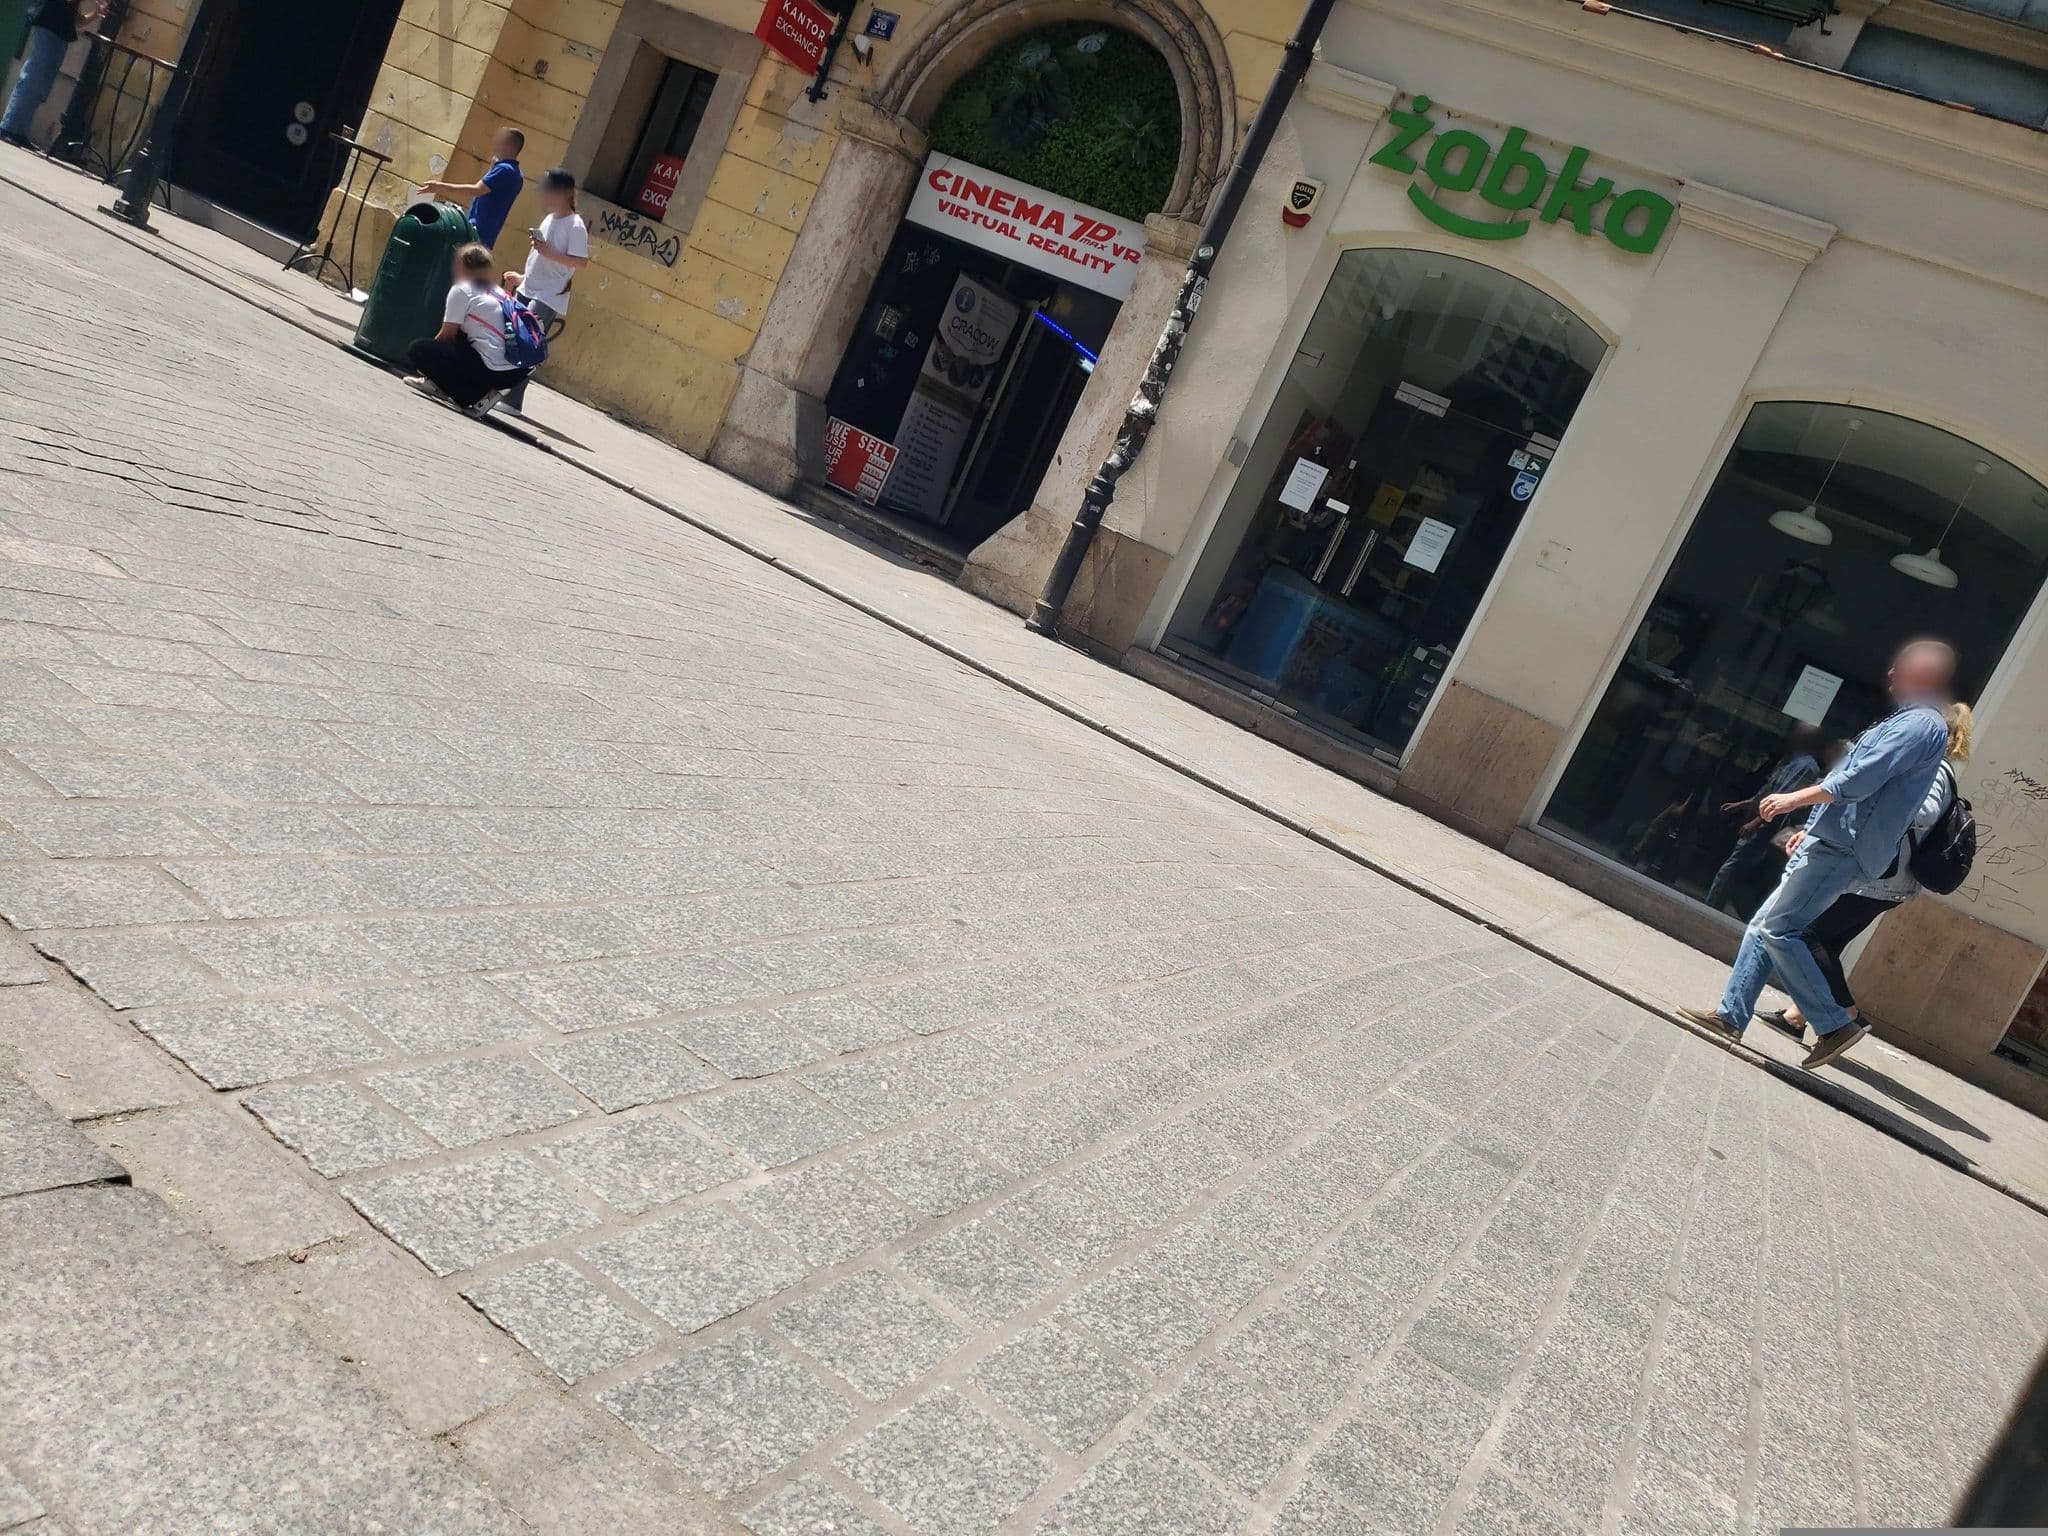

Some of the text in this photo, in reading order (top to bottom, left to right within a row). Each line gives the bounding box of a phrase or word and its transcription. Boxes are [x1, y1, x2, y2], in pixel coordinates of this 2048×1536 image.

[775, 16, 819, 57] EXCHANGE
[782, 0, 826, 41] KANTOR
[1369, 95, 1675, 254] żabka
[928, 169, 1065, 236] CINEMA
[1068, 214, 1117, 242] 7D
[1112, 243, 1142, 265] VR
[938, 199, 1116, 274] VIRTUAL REALITY
[951, 315, 1001, 350] CRACOW
[825, 432, 847, 449] USD
[830, 421, 887, 459] WE SELL
